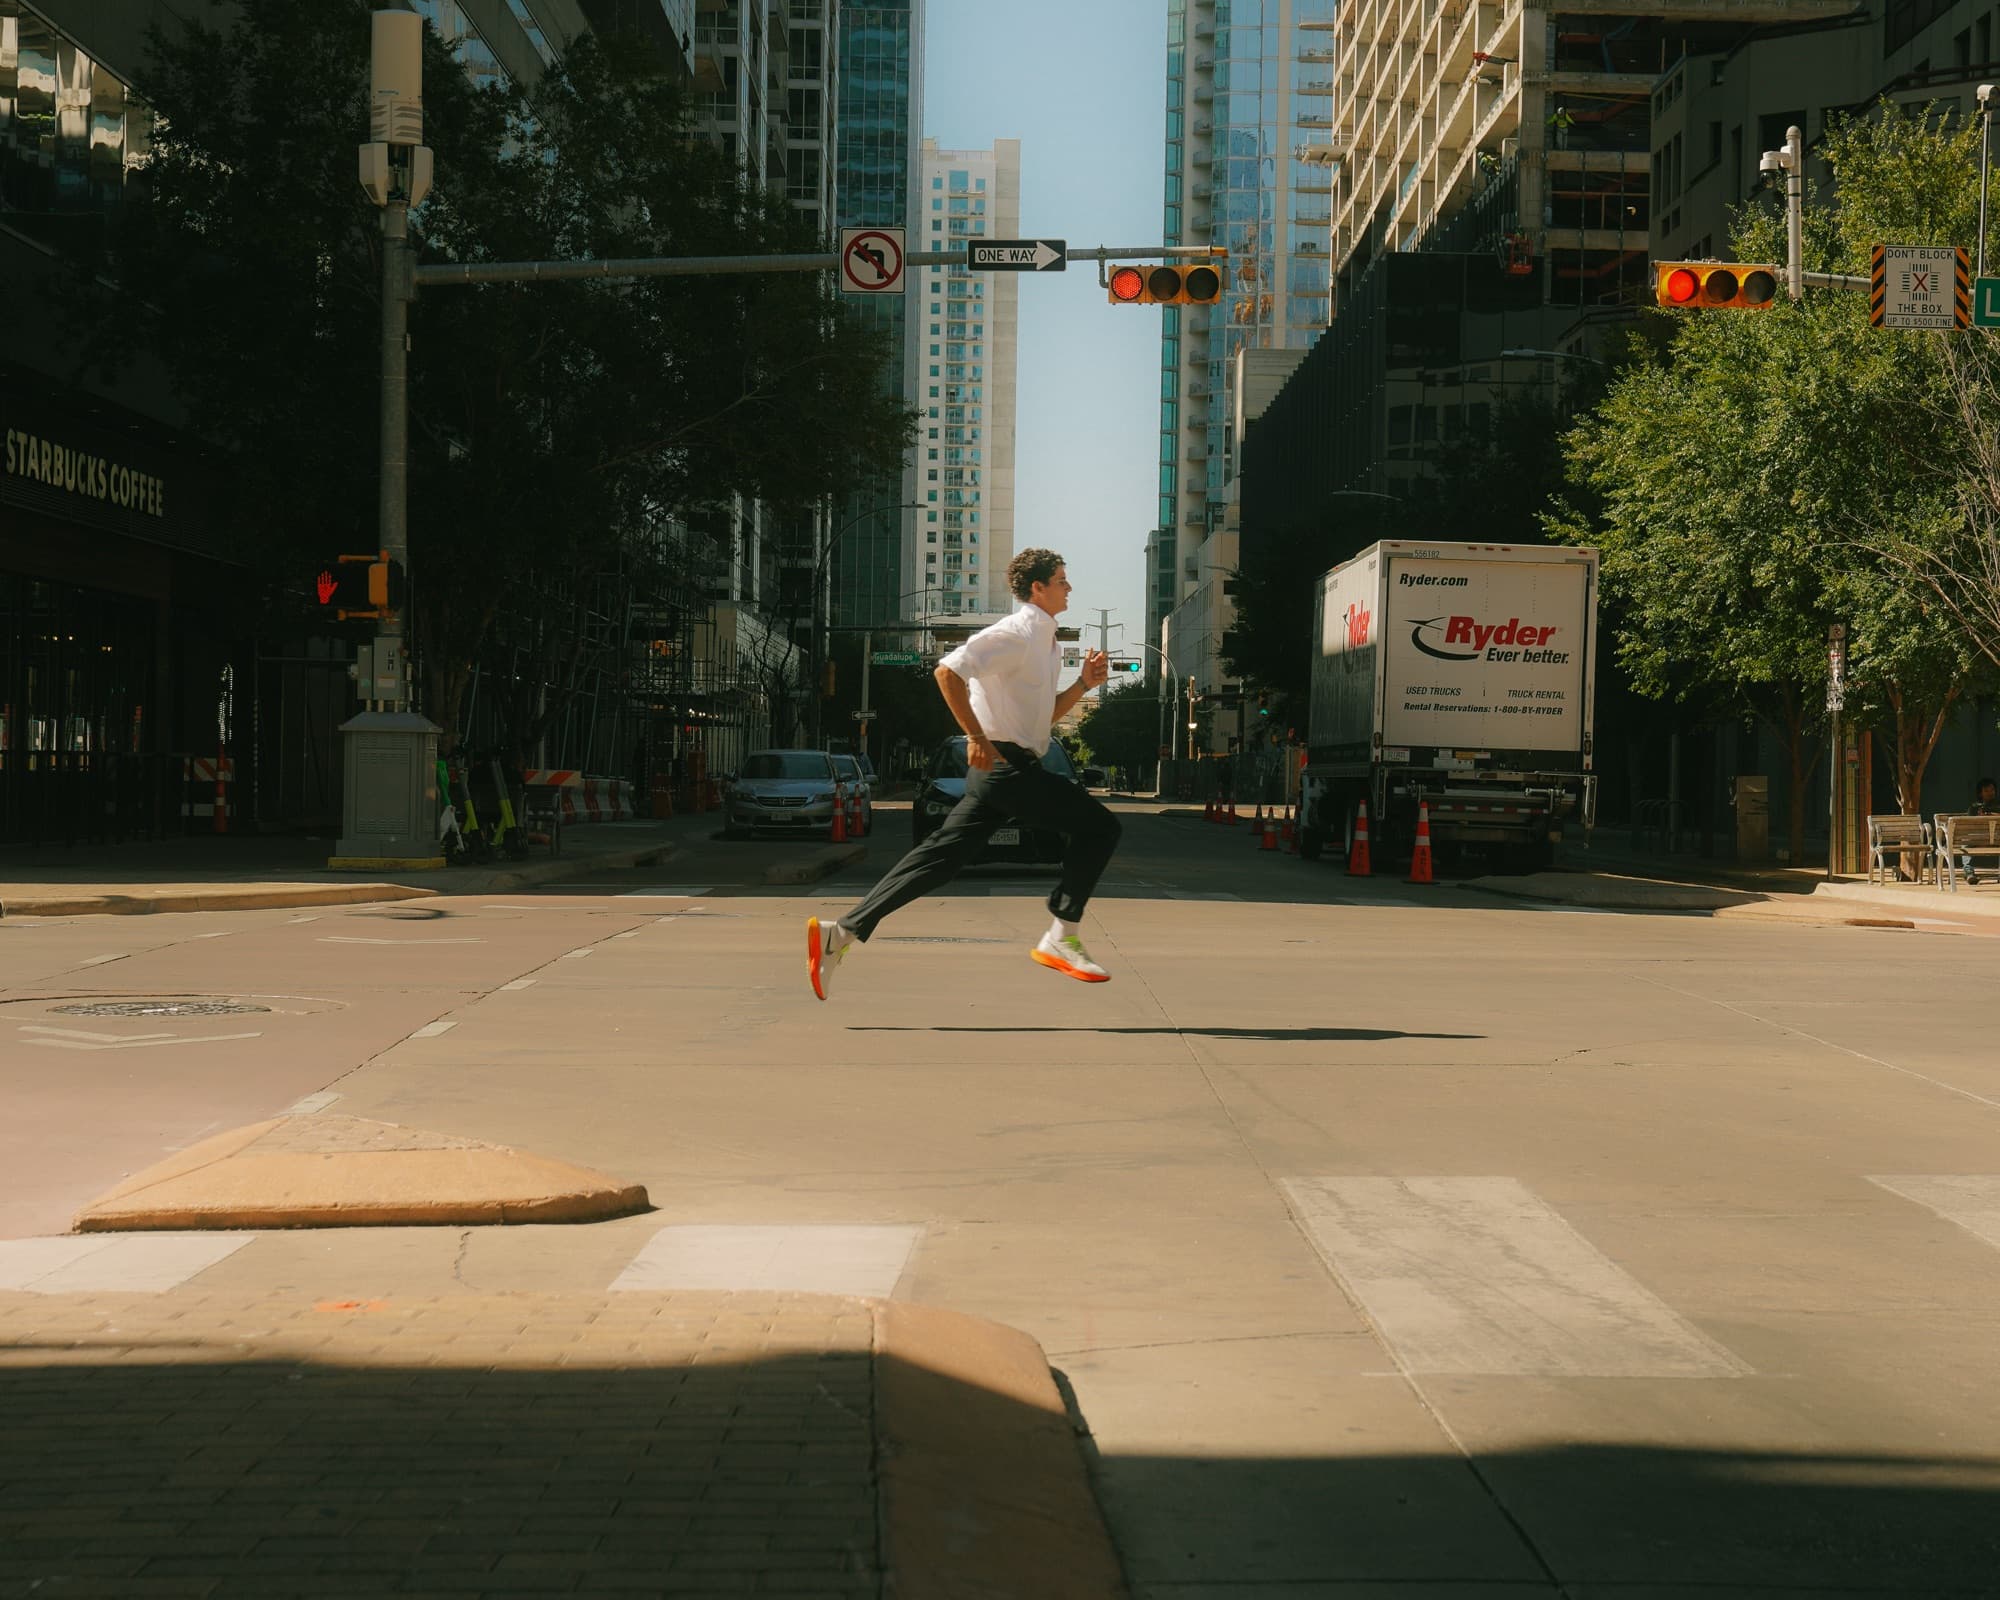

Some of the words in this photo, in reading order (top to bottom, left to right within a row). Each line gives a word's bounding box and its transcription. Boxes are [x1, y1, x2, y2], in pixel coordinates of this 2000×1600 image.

[978, 249, 1004, 261] ONE
[1009, 249, 1036, 261] WAY
[1887, 249, 1915, 259] DON'T
[1920, 250, 1953, 260] BLOCK
[1897, 304, 1917, 313] THE
[1922, 304, 1942, 313] BOX
[1887, 317, 1897, 325] UP
[1901, 317, 1911, 326] TO
[1914, 318, 1933, 326] $500
[1935, 318, 1952, 327] FINE
[6, 428, 107, 499] STARBUCKS
[110, 463, 164, 518] COFFEE
[1414, 550, 1440, 558] 556182
[1399, 573, 1468, 587] Ryder.com
[1445, 615, 1556, 651] Ryder
[1486, 648, 1520, 662] Ever
[1523, 649, 1569, 664] better.
[1406, 686, 1427, 695] USED
[1429, 687, 1462, 696] TRUCKS
[1507, 689, 1534, 699] TRUCK
[1535, 690, 1566, 700] RENTAL
[1403, 702, 1431, 711] Rental
[1433, 703, 1491, 713] Reservations:
[1494, 705, 1563, 715] 1-800-BY-RYDER
